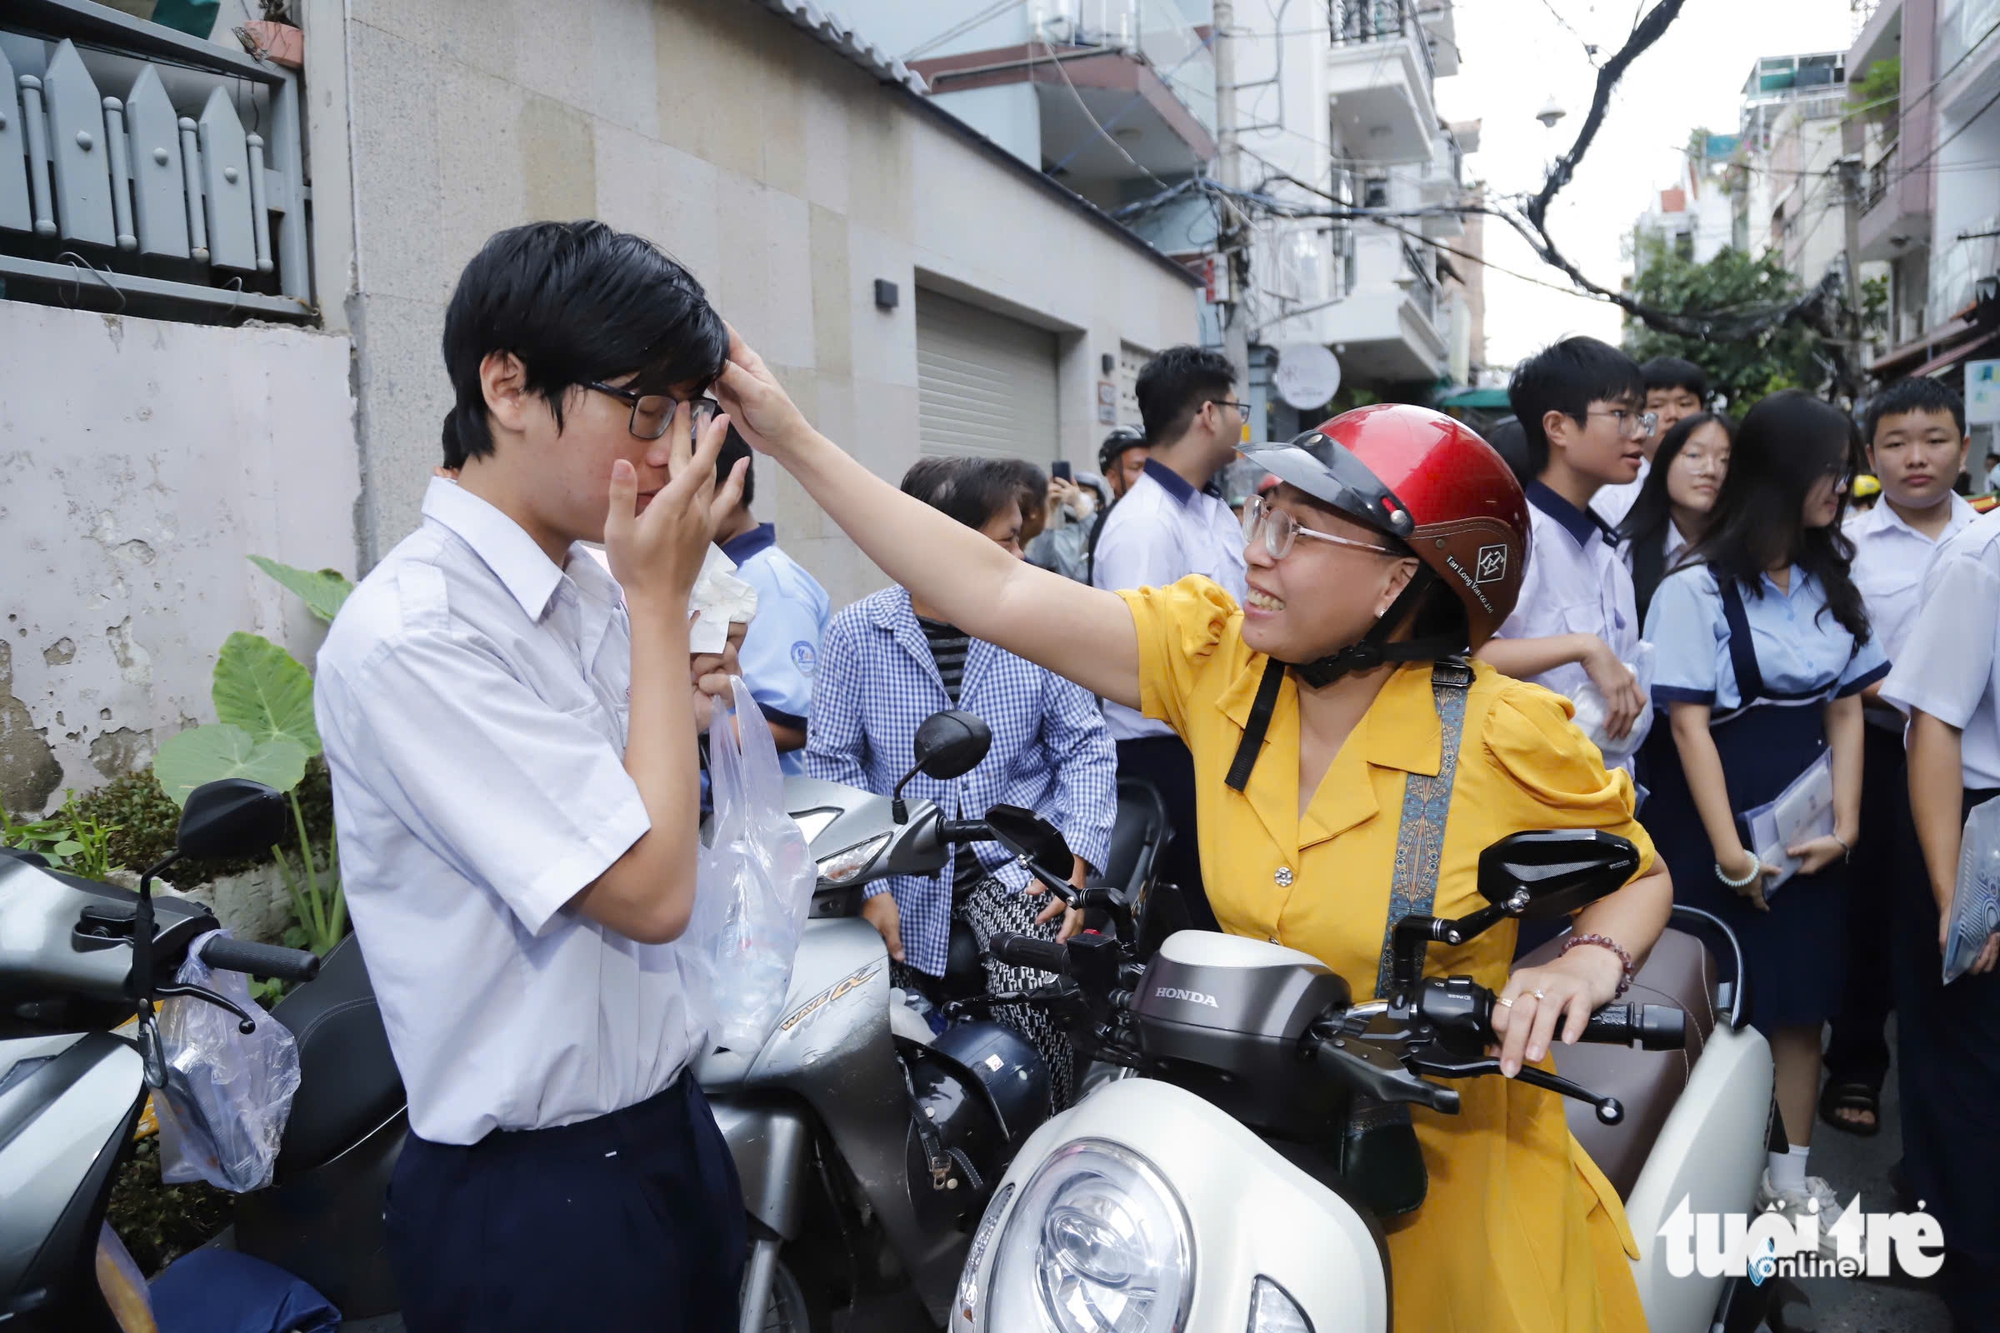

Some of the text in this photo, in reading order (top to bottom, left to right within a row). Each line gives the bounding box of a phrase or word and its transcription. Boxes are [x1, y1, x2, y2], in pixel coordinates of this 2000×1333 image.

[1447, 555, 1459, 570] Tan
[1457, 567, 1473, 587] Long
[1472, 582, 1482, 597] Van
[780, 990, 830, 1031] WAVE
[1155, 987, 1219, 1008] HONDA
